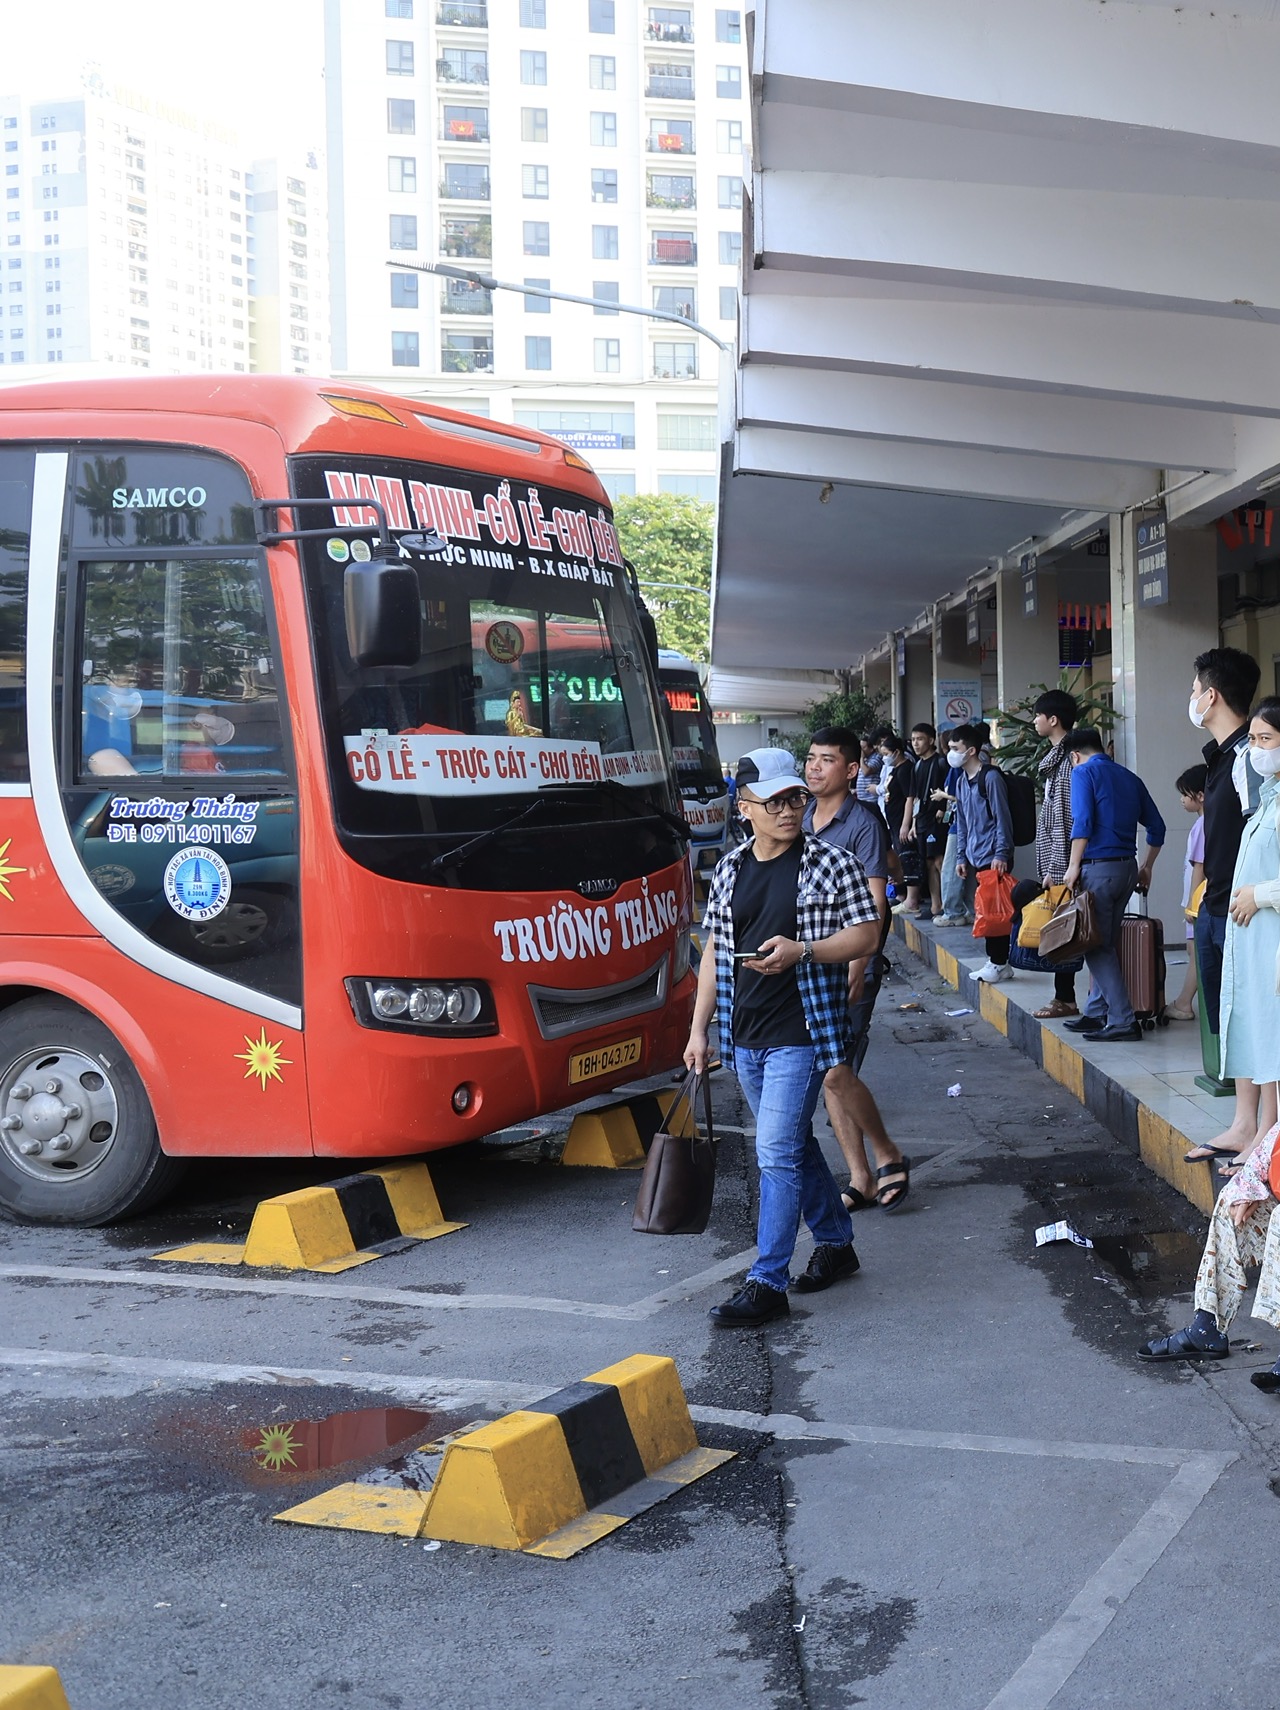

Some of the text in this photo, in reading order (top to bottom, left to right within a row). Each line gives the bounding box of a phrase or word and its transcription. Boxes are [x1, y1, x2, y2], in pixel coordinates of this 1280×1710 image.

[112, 486, 207, 508] SAMCO
[324, 471, 412, 529] NAM
[1091, 542, 1107, 555] 09
[472, 548, 515, 571] NINH
[530, 556, 555, 576] B.X
[558, 561, 590, 582] GIÁP
[592, 567, 615, 588] BÁT
[347, 736, 382, 784] CỔ
[388, 738, 416, 781] LỄ
[436, 749, 490, 785] TRỰC
[494, 745, 528, 780] CÁT
[538, 751, 571, 784] CHỢ
[573, 746, 602, 781] ĐỀN
[110, 796, 189, 821] Trường
[191, 794, 260, 821] Thắng
[107, 823, 257, 844] ĐT: 0911401167
[170, 894, 192, 916] NAM
[494, 900, 612, 963] TRƯỜNG
[578, 1043, 636, 1077] 18H-043.72
